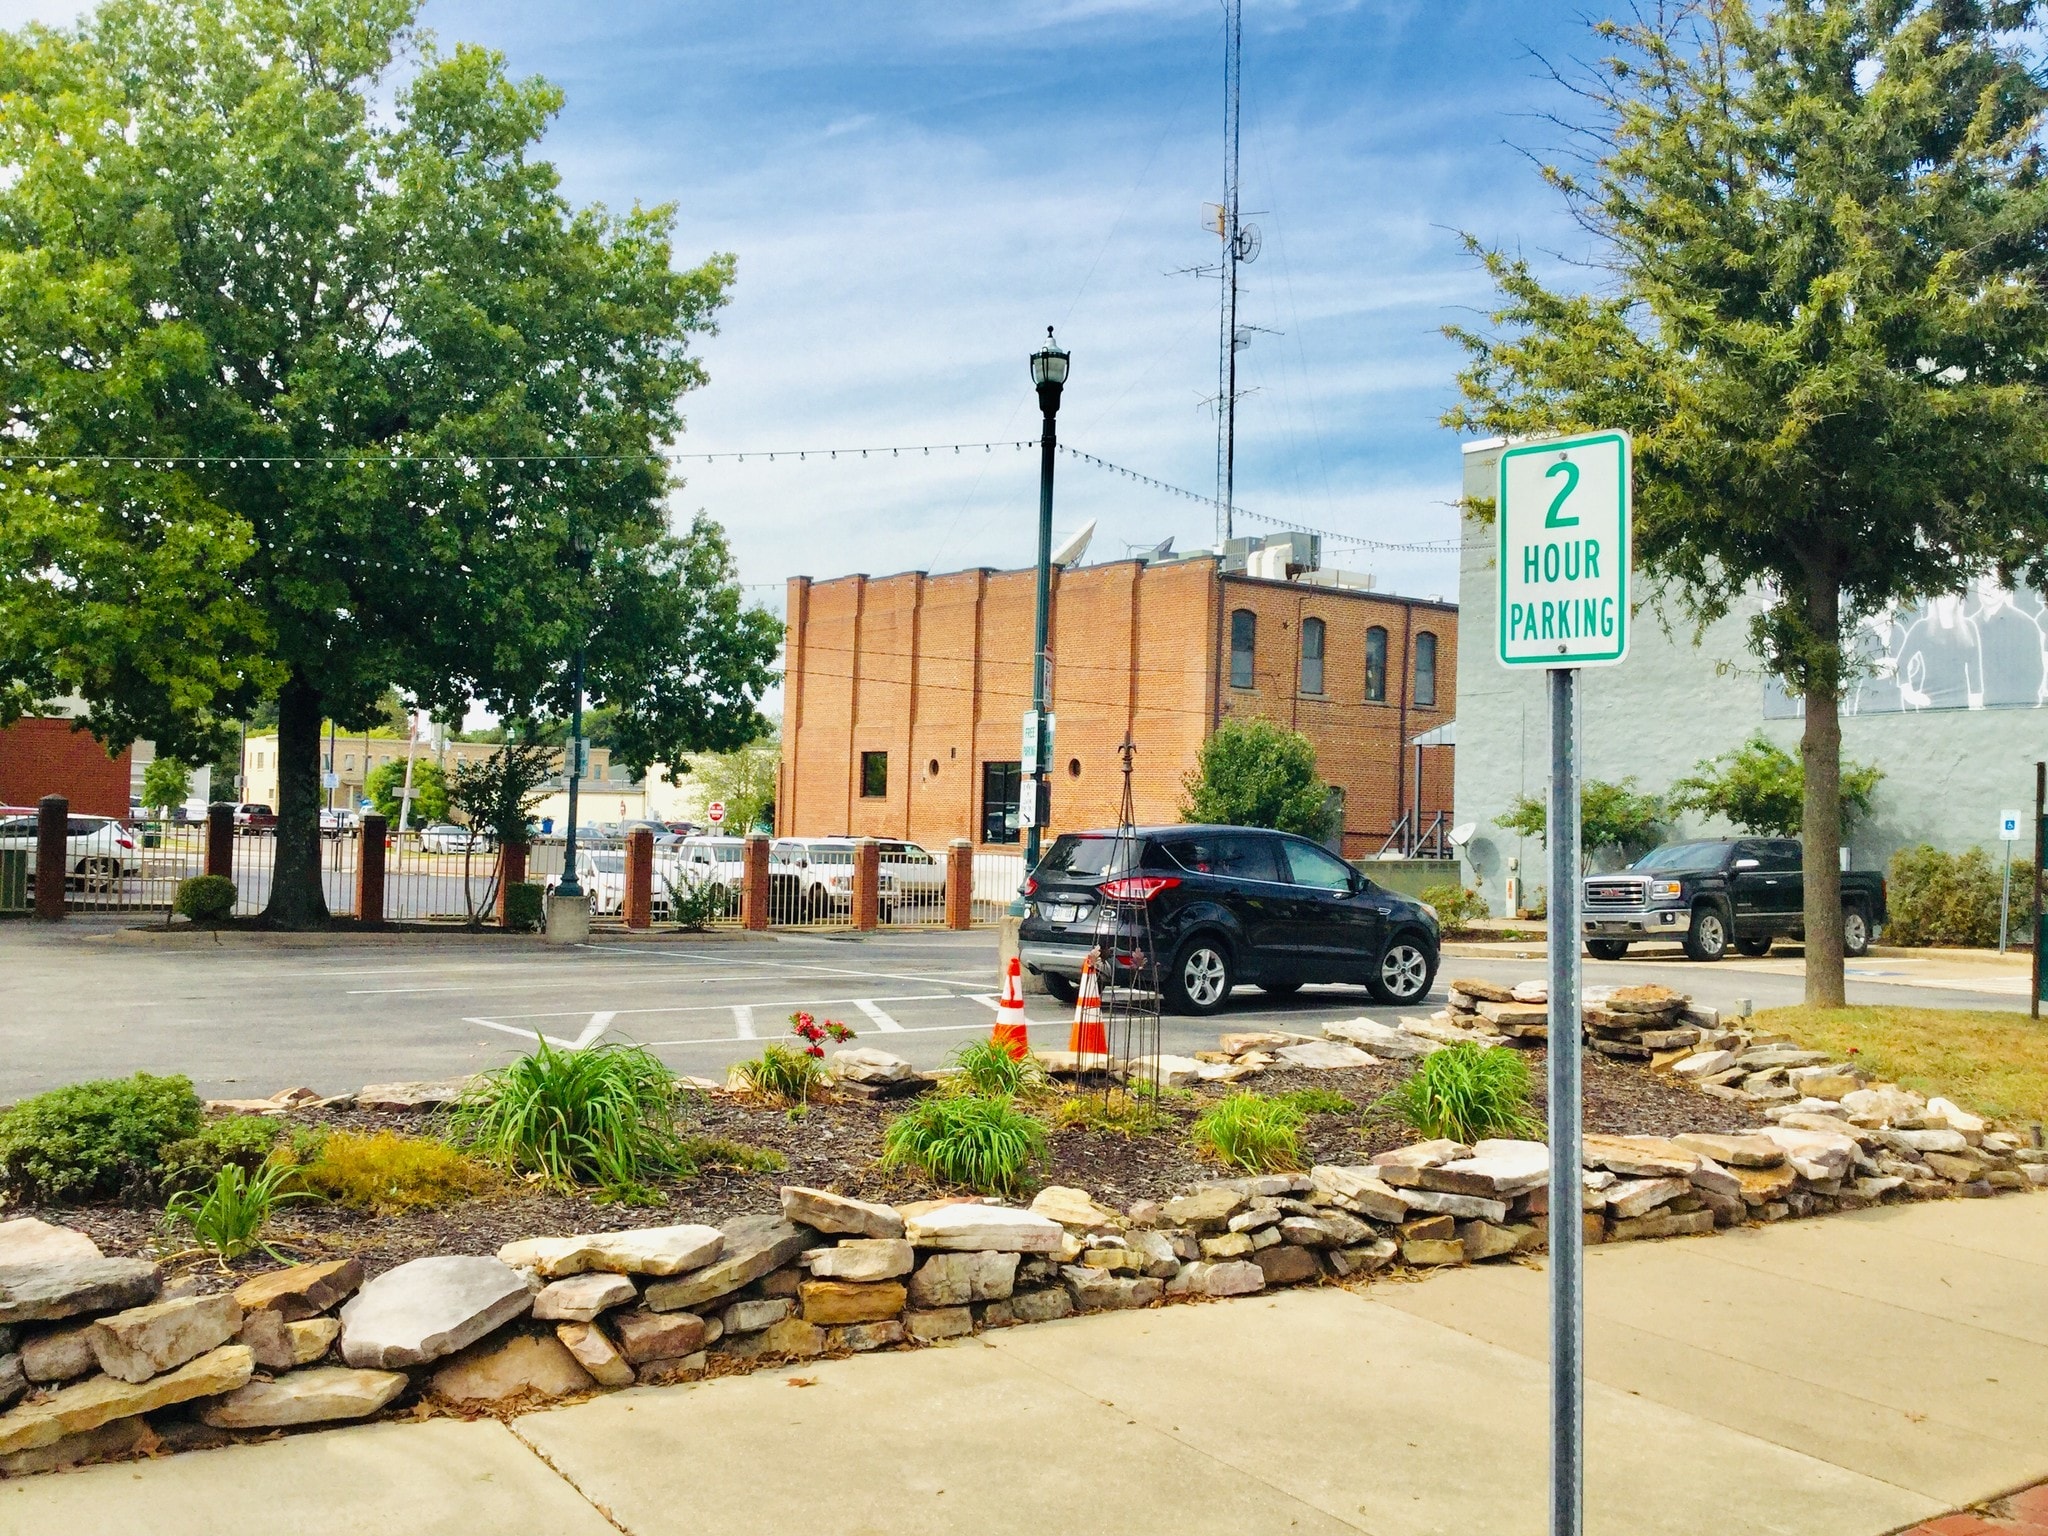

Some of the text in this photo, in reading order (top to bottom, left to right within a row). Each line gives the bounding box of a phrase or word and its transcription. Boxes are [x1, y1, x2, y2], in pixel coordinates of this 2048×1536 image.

[1545, 461, 1580, 529] 2
[1524, 539, 1600, 583] HOUR
[1511, 597, 1614, 641] PARKING
